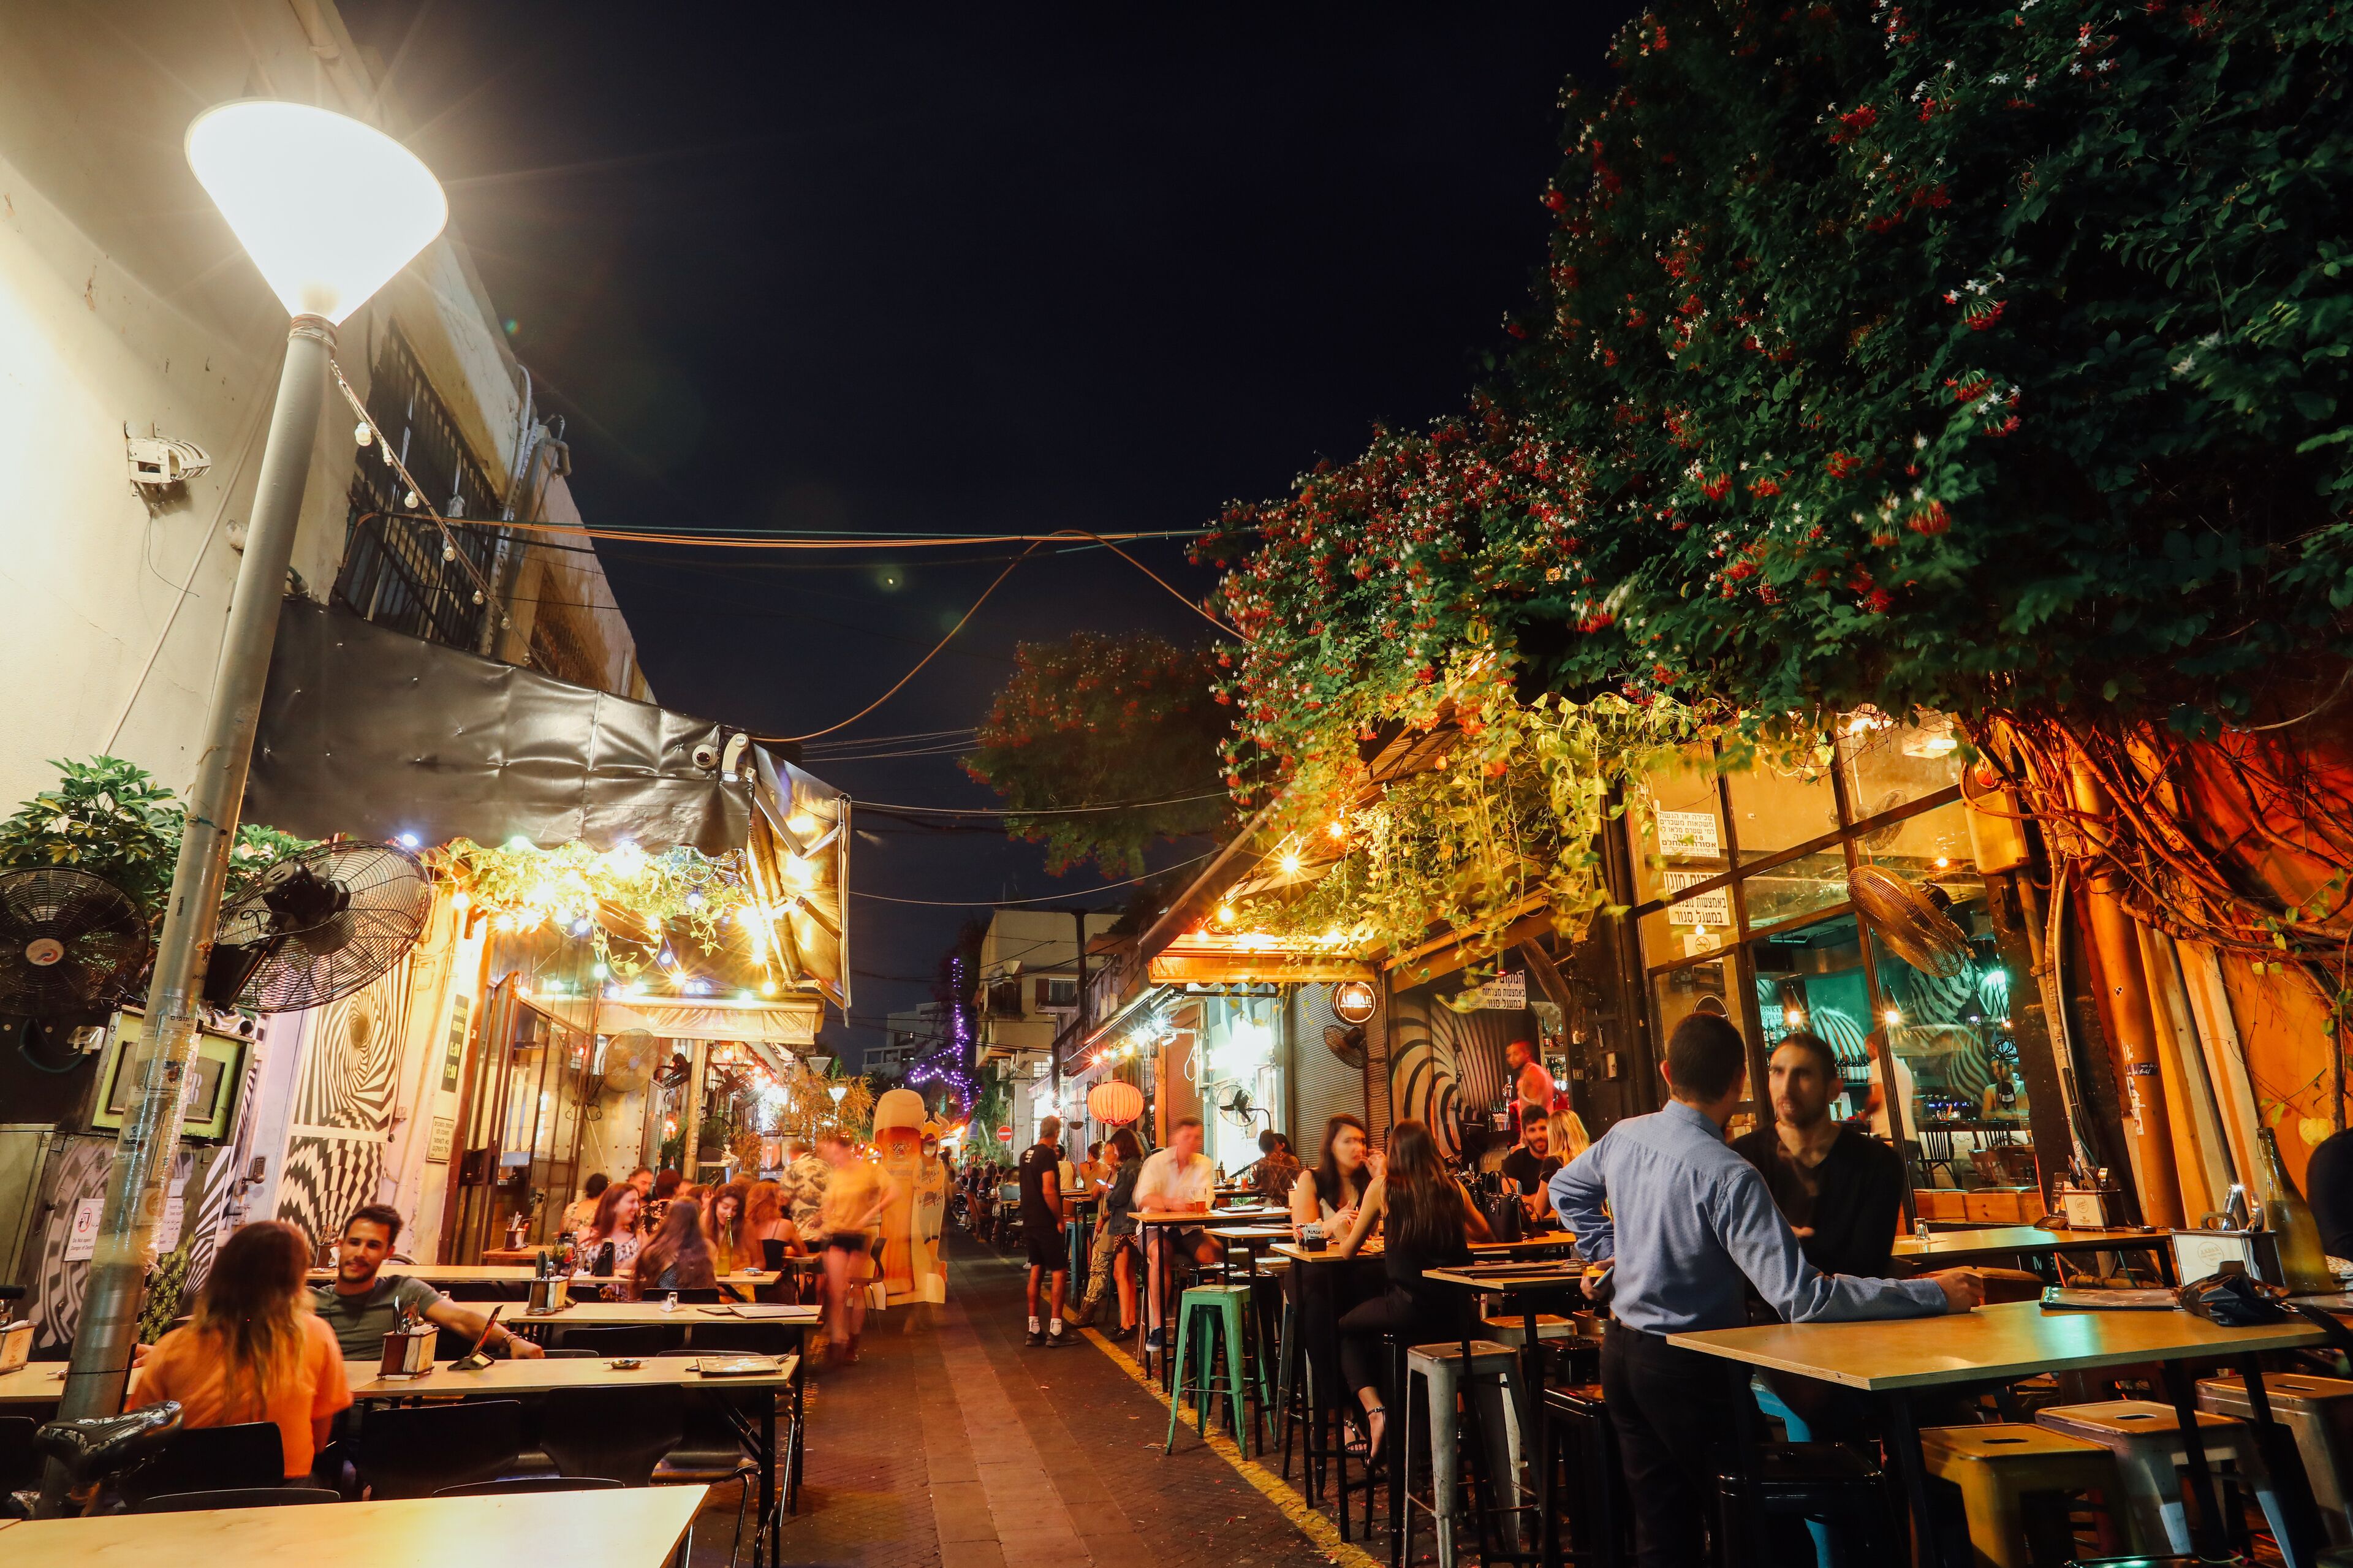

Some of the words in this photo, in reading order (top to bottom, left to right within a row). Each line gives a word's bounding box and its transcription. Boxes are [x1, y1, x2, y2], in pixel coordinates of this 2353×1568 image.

[1696, 897, 1727, 908] באמצעות
[1675, 911, 1693, 923] סגור
[1696, 910, 1723, 923] במעגל
[1482, 987, 1501, 996] מצלמות
[1503, 988, 1525, 997] באמצעות
[1487, 999, 1500, 1008] סגור
[1502, 998, 1522, 1009] במעגל
